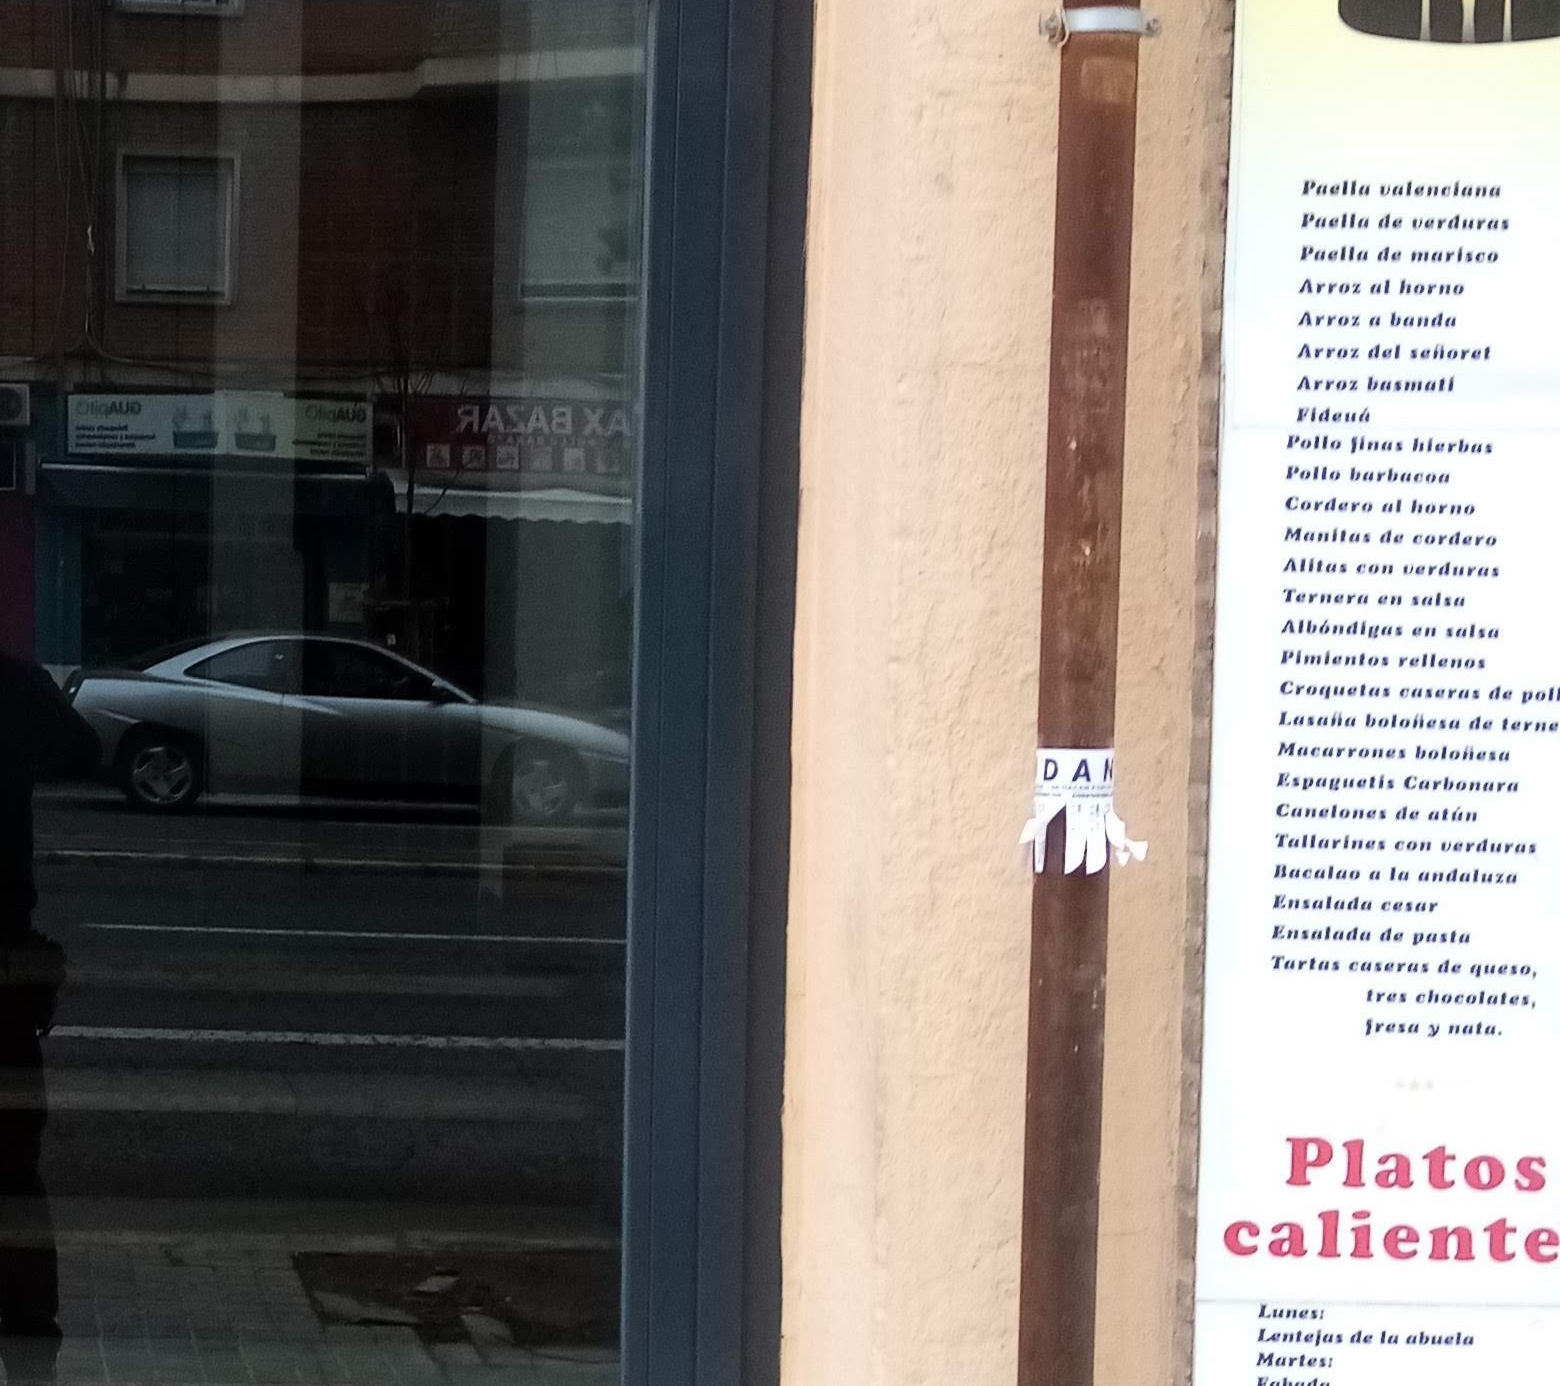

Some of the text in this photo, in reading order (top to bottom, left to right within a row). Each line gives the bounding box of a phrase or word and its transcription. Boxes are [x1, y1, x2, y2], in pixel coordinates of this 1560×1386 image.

[1301, 179, 1501, 198] Paella valenciana
[1300, 212, 1510, 232] Paella de verduras
[1299, 244, 1499, 264] Paella de marisco
[1298, 277, 1465, 296] Arroz al horno
[1297, 310, 1457, 328] Arroz a banda
[1296, 342, 1491, 361] Arroz del señoret
[1296, 375, 1455, 393] Arroz basmati
[1296, 406, 1371, 424] Fideuá
[1286, 434, 1493, 455] Pollo finas hierbas
[1285, 464, 1450, 485] Pollo barbacoa
[1284, 495, 1476, 516] Cordero al horno
[1283, 526, 1498, 547] Manitas de cordero
[1282, 557, 1500, 578] Alitas con verduras
[1282, 588, 1466, 608] Ternera en salsa
[1280, 618, 1500, 640] Albóndigas en salsa
[1280, 649, 1486, 670] Pimientos rellenos
[1279, 680, 1391, 700] Croquetas
[1399, 687, 1480, 701] caseras
[1488, 684, 1513, 701] de
[1278, 710, 1357, 728] Lasaña
[1364, 712, 1461, 731] boloñesa
[1468, 715, 1494, 731] de
[1277, 741, 1510, 763] Macarrones boloñesa
[1276, 772, 1519, 793] Espaguetis Carbonara
[1275, 802, 1478, 823] Canelones de atún
[1274, 832, 1537, 855] Tallarines con verduras
[1273, 864, 1518, 885] Bacalao a la andaluza
[1272, 894, 1439, 913] Ensalada cesar
[1271, 924, 1471, 947] Ensalada de pasta
[1270, 954, 1340, 972] Tartas
[1348, 960, 1429, 974] caseras
[1437, 958, 1462, 975] de
[1366, 988, 1407, 1004] tres
[1364, 1018, 1420, 1037] fresa
[1427, 1023, 1440, 1038] y
[1286, 1136, 1547, 1193] Platos
[1223, 1210, 1560, 1264] caliente
[1257, 1327, 1475, 1348] Lentejas de la abuela
